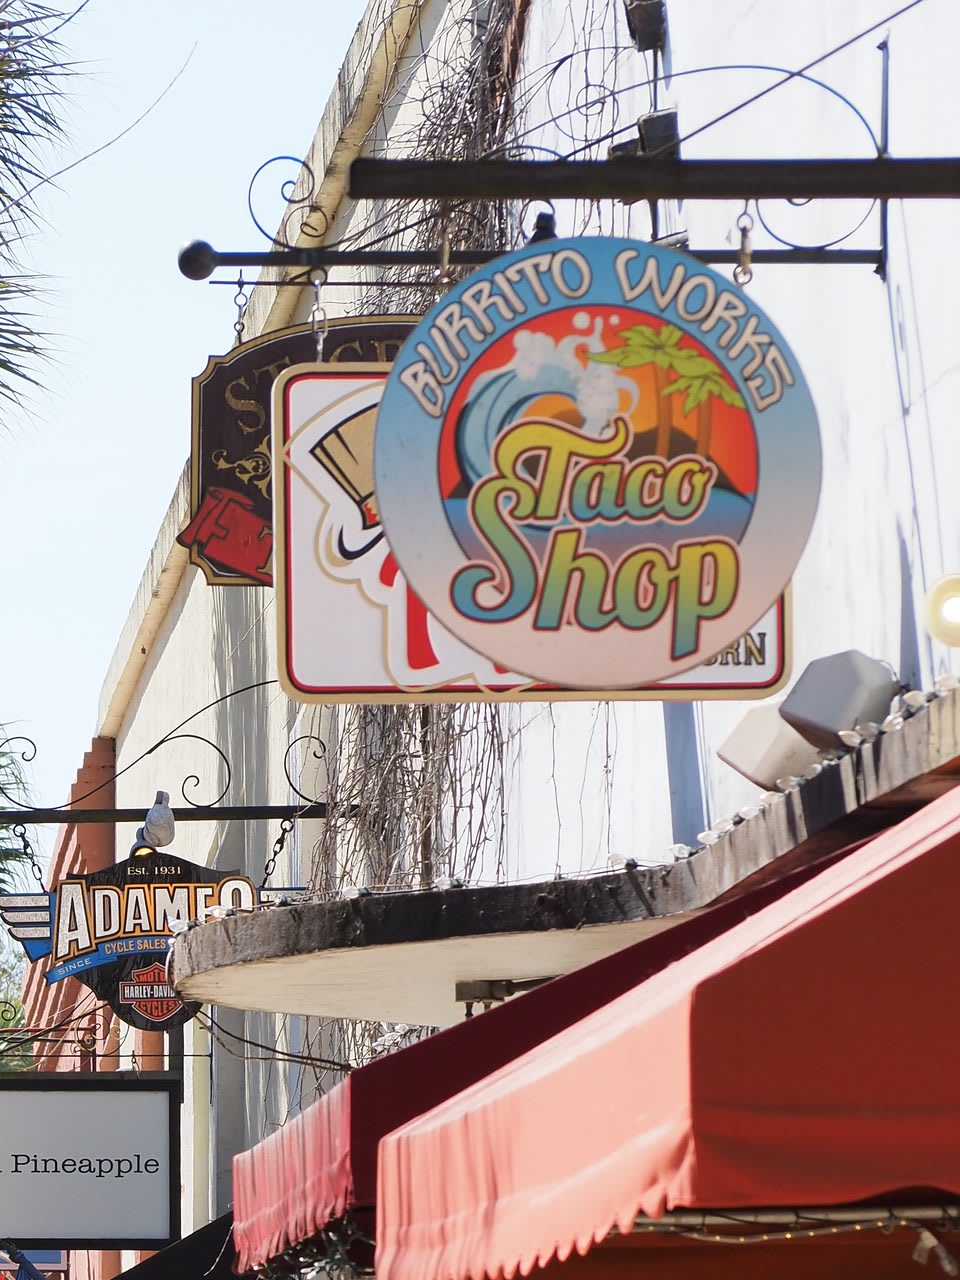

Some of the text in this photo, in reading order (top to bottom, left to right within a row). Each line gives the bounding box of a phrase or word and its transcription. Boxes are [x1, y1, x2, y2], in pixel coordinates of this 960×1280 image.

[400, 248, 795, 419] BURRITO WORKS
[494, 416, 713, 523] Taco
[450, 476, 740, 661] Shop
[127, 866, 182, 876] Est. 1931
[104, 939, 166, 955] CYCLE SALES
[58, 958, 92, 976] SINCE
[139, 969, 174, 982] MOTO
[140, 1001, 175, 1016] CYCLES
[10, 1154, 160, 1178] Pineapple
